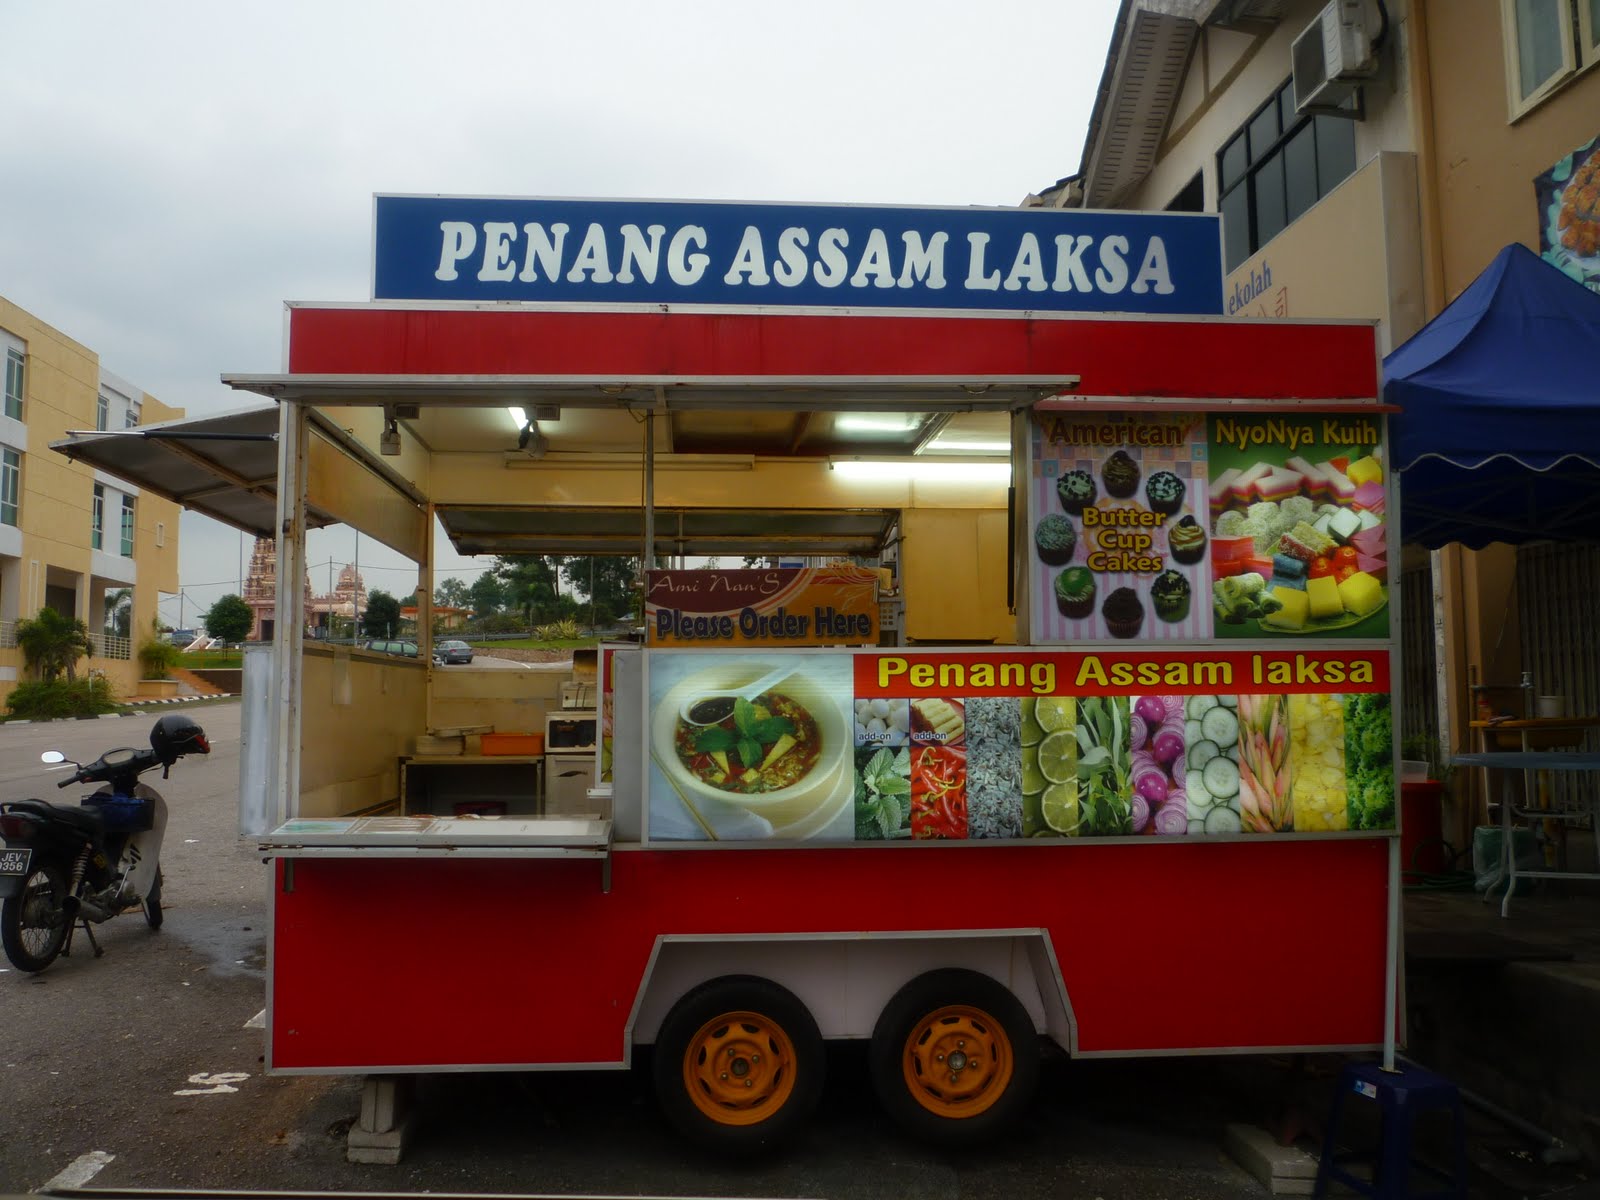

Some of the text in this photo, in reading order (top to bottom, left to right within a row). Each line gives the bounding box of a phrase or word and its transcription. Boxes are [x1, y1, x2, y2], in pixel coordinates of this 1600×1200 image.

[434, 221, 1175, 294] PENANG ASSAM LAKSA
[1227, 260, 1272, 316] ekolah
[1049, 416, 1185, 447] American
[1215, 419, 1377, 450] NyoNya Kuih
[1082, 507, 1166, 527] Butter
[1097, 530, 1151, 553] Cup
[1087, 552, 1162, 573] Cakes
[650, 574, 700, 594] Ami
[656, 606, 871, 639] Please Order Here
[878, 654, 1374, 694] Penang Assam laksa
[858, 732, 892, 741] add-on
[914, 731, 947, 741] add-on
[1, 852, 23, 862] JEV
